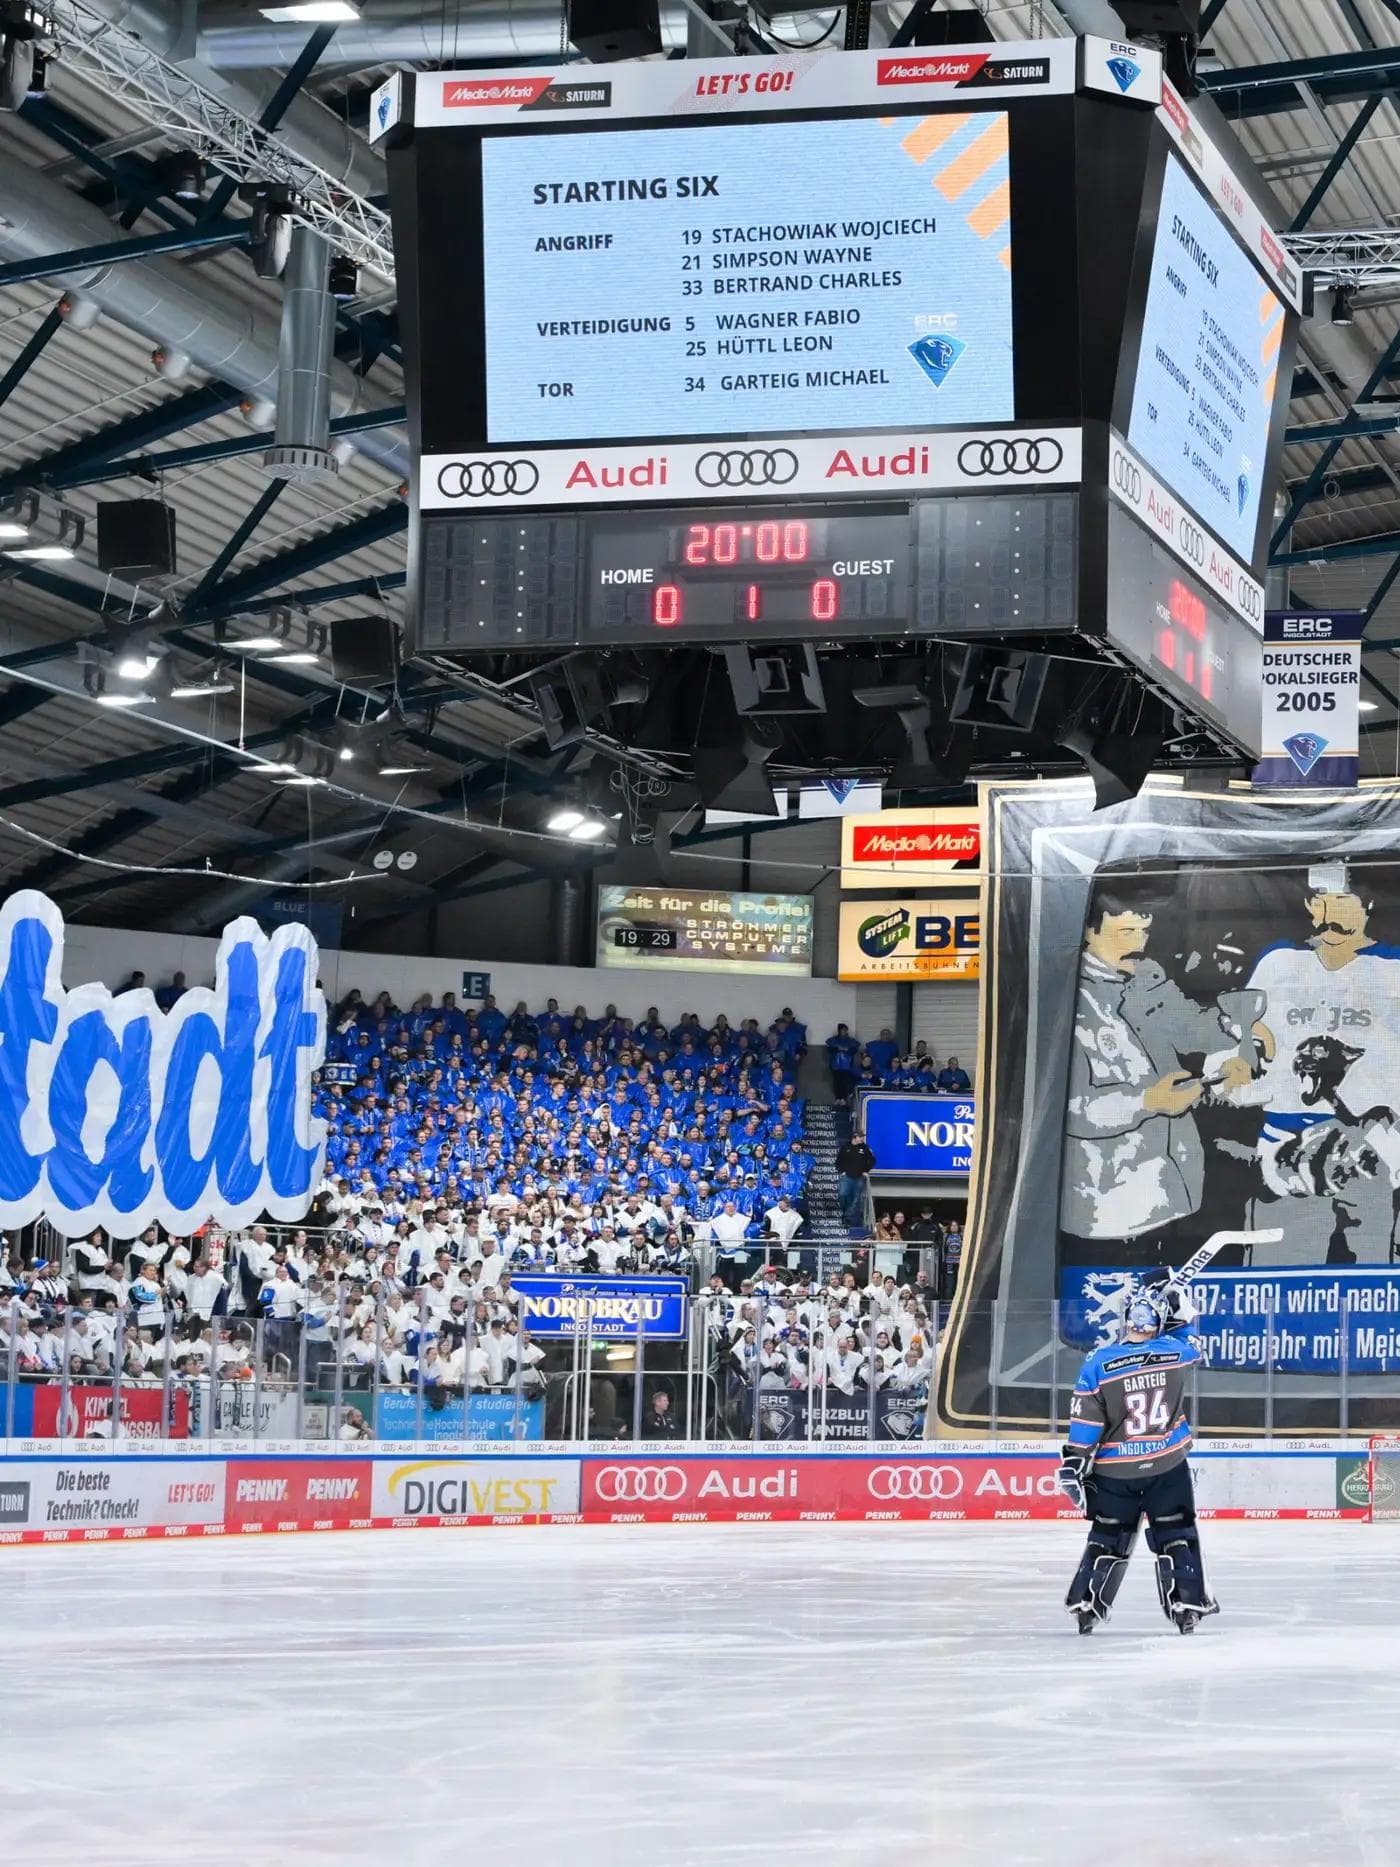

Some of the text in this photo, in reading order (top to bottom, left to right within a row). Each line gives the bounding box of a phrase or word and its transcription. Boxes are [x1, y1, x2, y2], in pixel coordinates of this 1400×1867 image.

[1110, 43, 1136, 54] ERC
[697, 71, 794, 96] LET'S GO!
[1004, 66, 1043, 79] SATURN
[566, 89, 604, 102] SATURN
[533, 175, 719, 205] STARTING SIX
[534, 218, 936, 252] ANGRIFF 19 STACHOWIAK WOJCIECH
[681, 246, 872, 270] 21 SIMPSON WAYNE
[1172, 214, 1220, 288] STARTING SIX
[682, 271, 902, 296] 33 BERTRAND CHARLES
[1166, 266, 1188, 298] ANGRIFF
[536, 308, 860, 336] VERTEIDIGUNG 5 WAGNER FABIO
[686, 336, 833, 356] 25 HÜTTL LEON
[536, 369, 889, 398] TOR 34 GARTEIG MICHAEL
[565, 446, 929, 489] Audi Audi
[686, 521, 808, 565] 20:00
[1147, 489, 1233, 593] Audi Audi
[600, 567, 654, 584] HOME
[832, 560, 894, 577] GUEST
[655, 586, 678, 625] 0
[748, 585, 758, 620] 1
[814, 581, 836, 621] 0
[1282, 618, 1332, 632] ERC
[1264, 652, 1352, 666] DEUTSCHER
[1276, 692, 1336, 712] 2005
[274, 902, 306, 913] BLUE
[609, 894, 653, 910] Zeit
[660, 898, 694, 911] für
[700, 898, 731, 912] die
[686, 918, 807, 934] STRÖHMER
[864, 912, 903, 940] SYSTEM
[882, 928, 904, 947] LIFT
[686, 932, 807, 944] COMPUTER
[692, 940, 801, 954] SYSTEME
[470, 976, 484, 996] E
[1234, 1283, 1280, 1314] ERCI
[1288, 1282, 1340, 1313] wird
[1347, 1281, 1398, 1312] nach
[1124, 1372, 1166, 1393] GARTEIG
[1125, 1390, 1169, 1436] 34
[56, 1470, 110, 1491] Die beste
[698, 1470, 798, 1498] Audi
[168, 1484, 215, 1503] LET'S GO!
[404, 1480, 557, 1514] DIGIVEST
[46, 1498, 139, 1520] Technik? Check!
